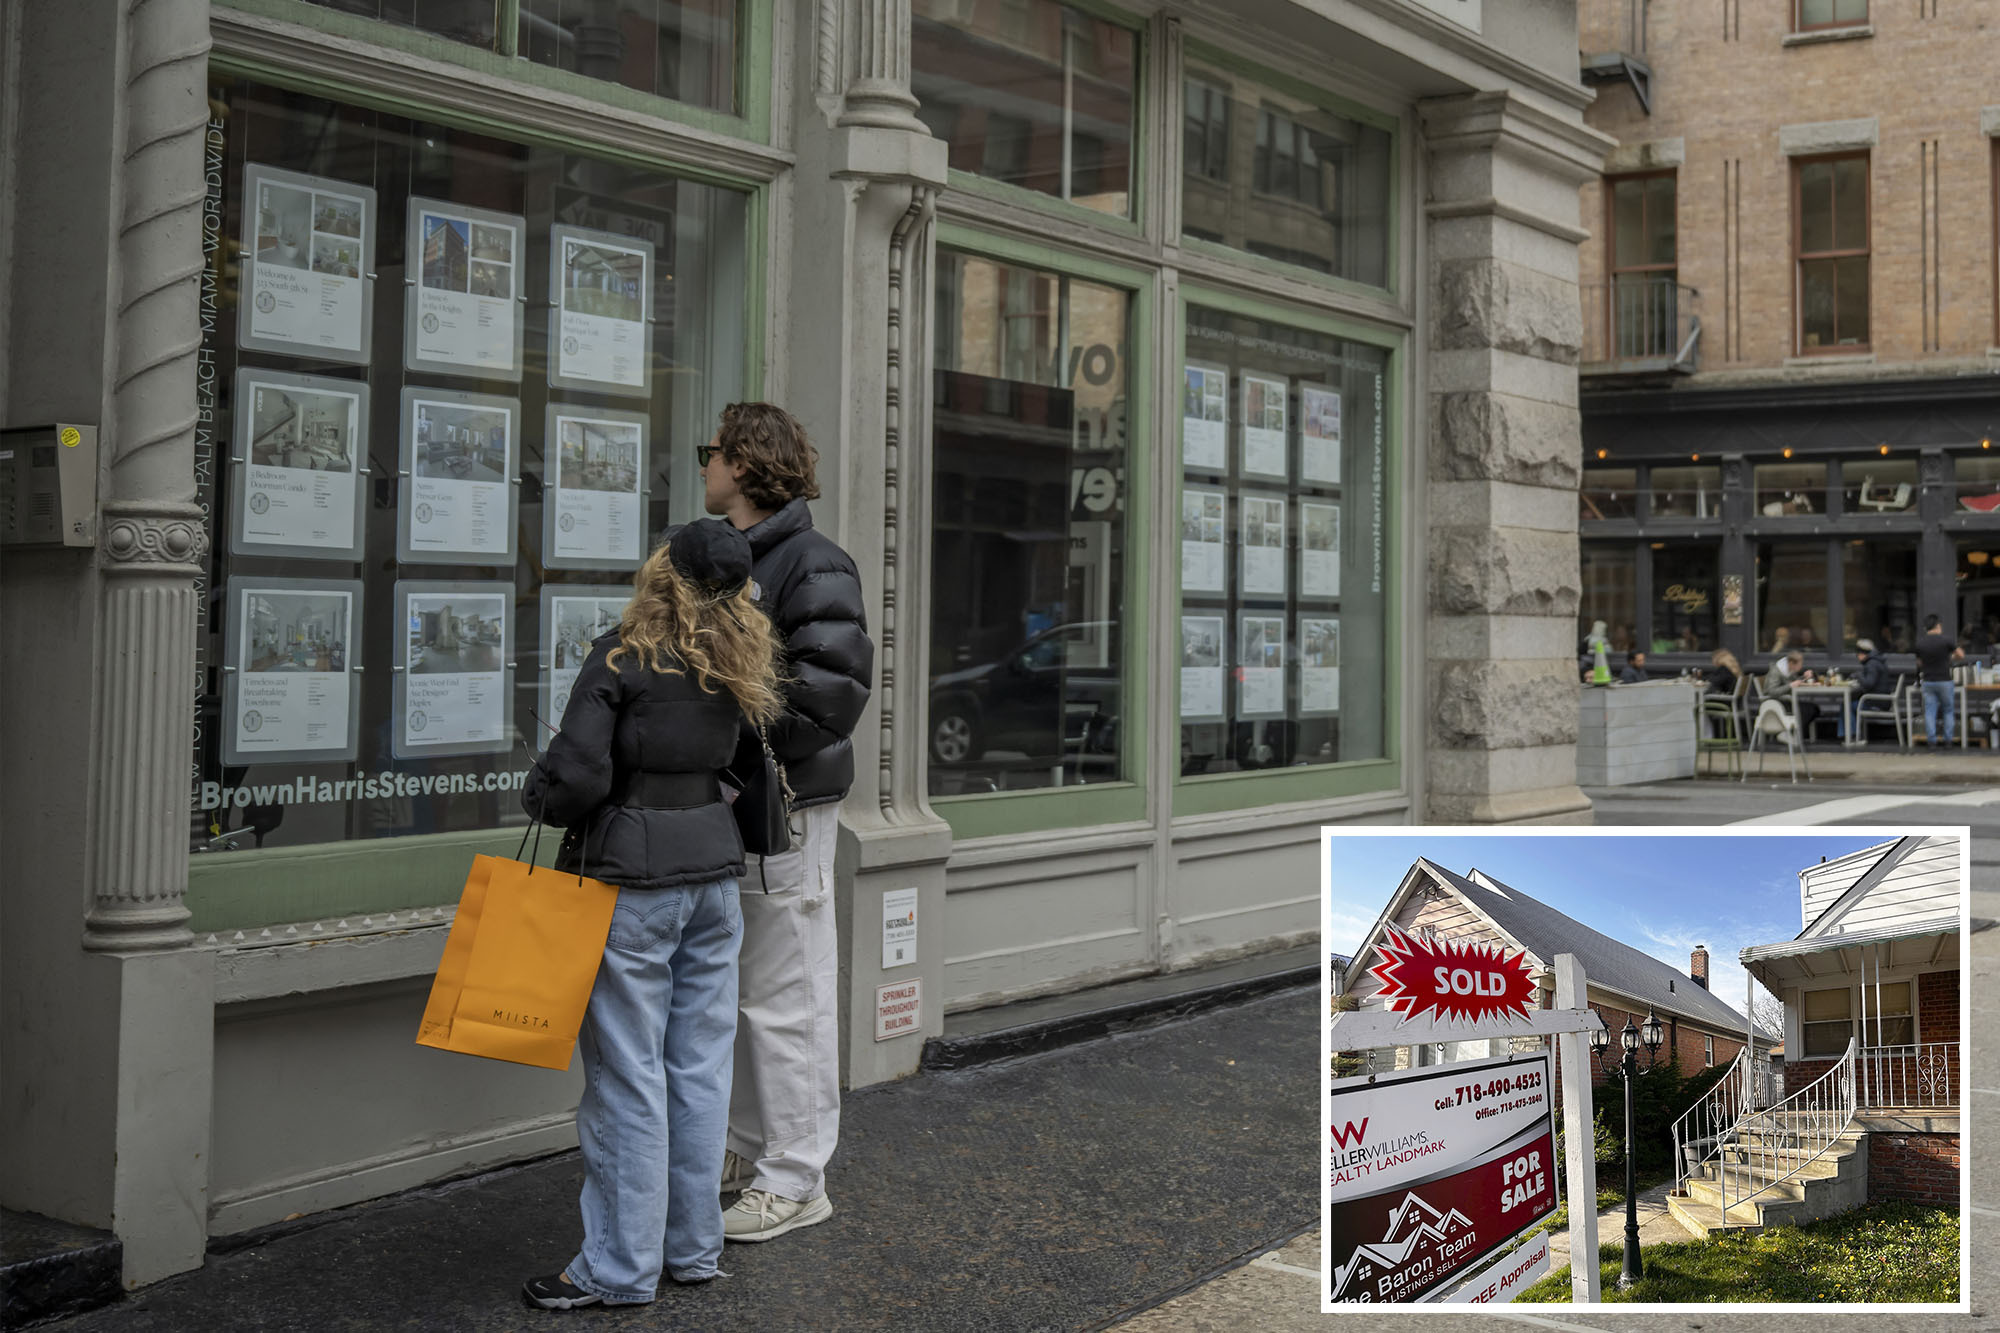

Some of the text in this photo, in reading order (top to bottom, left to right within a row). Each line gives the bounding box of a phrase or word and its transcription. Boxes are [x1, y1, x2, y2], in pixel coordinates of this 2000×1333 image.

[203, 118, 224, 253] WORLDWIDE
[200, 269, 218, 333] MIAMI
[198, 349, 215, 423] BEACH
[195, 429, 212, 486] PALM
[1372, 374, 1382, 593] BrownHarrisStevens.com
[882, 986, 916, 1003] SPRINKLER
[1433, 966, 1506, 997] SOLD
[493, 1009, 549, 1028] MIISTA
[879, 999, 919, 1017] THROUGHOUT
[885, 1015, 913, 1031] BUILDING
[1435, 1071, 1541, 1111] Cell: 718-490-4523
[1331, 1116, 1369, 1152] W
[1475, 1107, 1499, 1121] Office:
[1377, 1139, 1446, 1171] LANDMARK
[1502, 1150, 1540, 1186] FOR
[1501, 1171, 1545, 1214] SALE
[1377, 1231, 1476, 1297] Baron Team
[1390, 1271, 1435, 1303] LISTINGS
[1436, 1258, 1458, 1276] SELL
[1500, 1245, 1546, 1291] Appraisal
